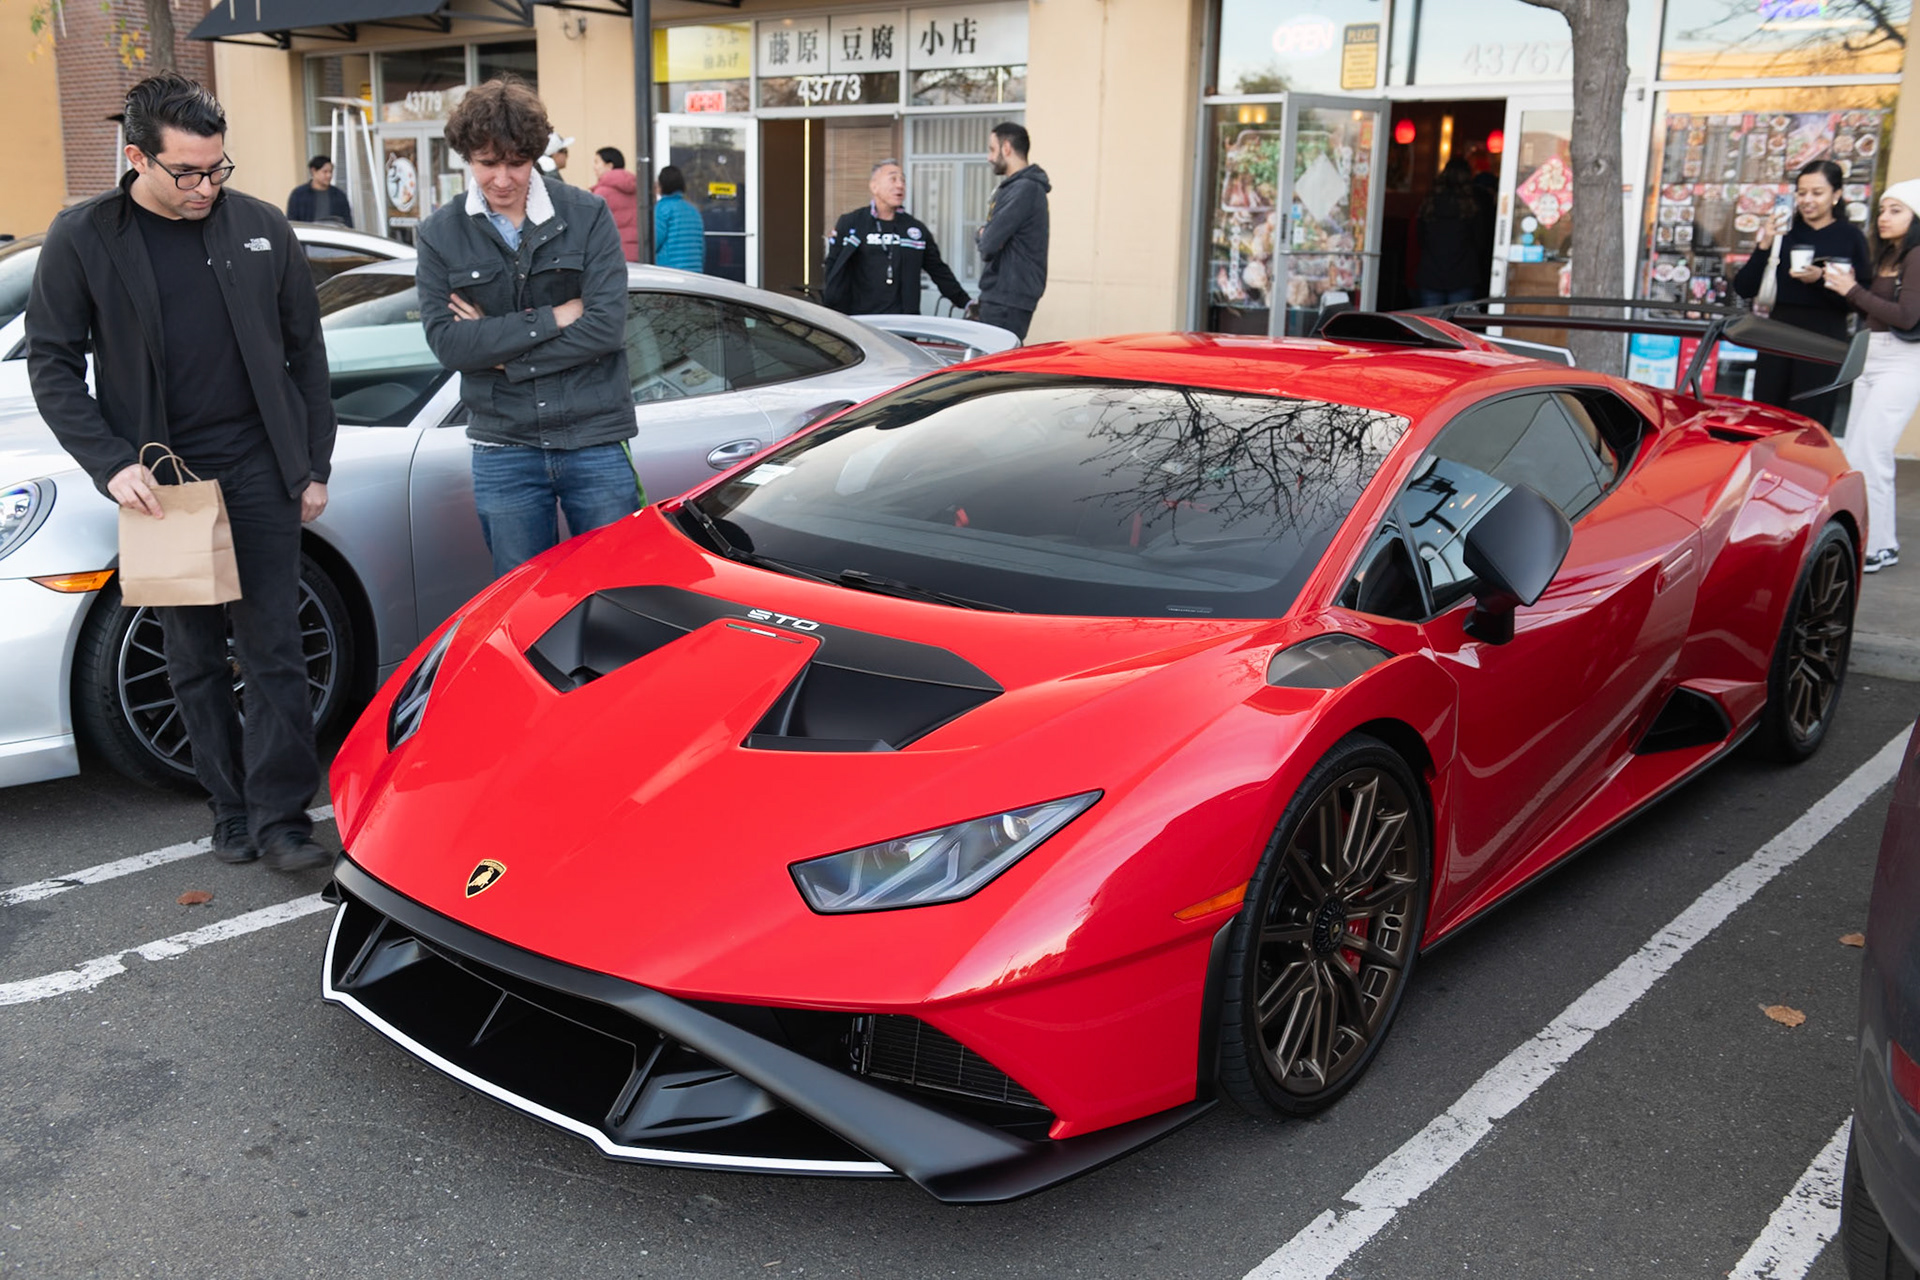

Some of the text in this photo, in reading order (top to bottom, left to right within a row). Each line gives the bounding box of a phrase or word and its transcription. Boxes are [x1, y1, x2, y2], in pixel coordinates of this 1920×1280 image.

[1272, 22, 1335, 53] OPEN
[1462, 40, 1574, 77] 43767
[404, 90, 443, 112] 43779
[797, 74, 861, 102] 43773
[747, 609, 820, 631] STO
